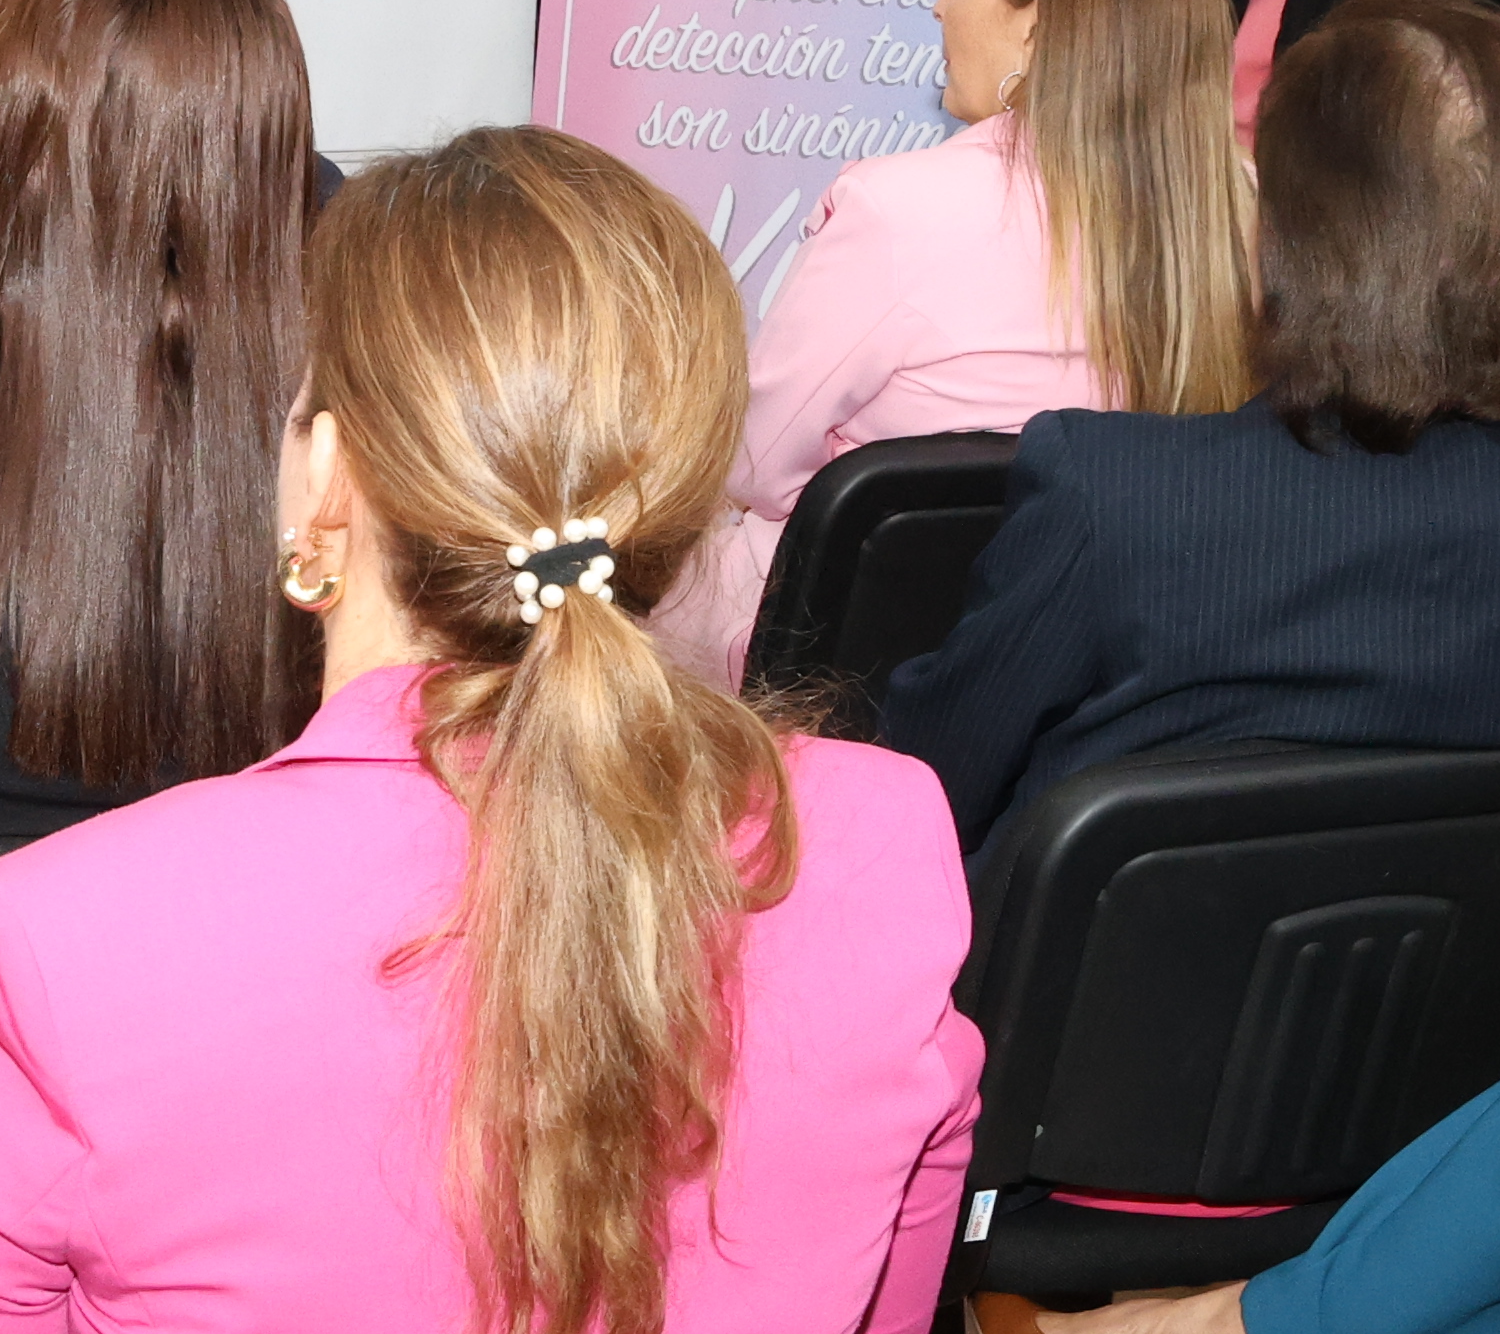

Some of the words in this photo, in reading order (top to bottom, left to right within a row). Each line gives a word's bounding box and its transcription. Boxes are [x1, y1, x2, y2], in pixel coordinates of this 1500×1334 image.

[611, 3, 852, 82] detección
[860, 22, 948, 91] tem
[638, 100, 733, 151] son
[742, 103, 968, 159] sinónim
